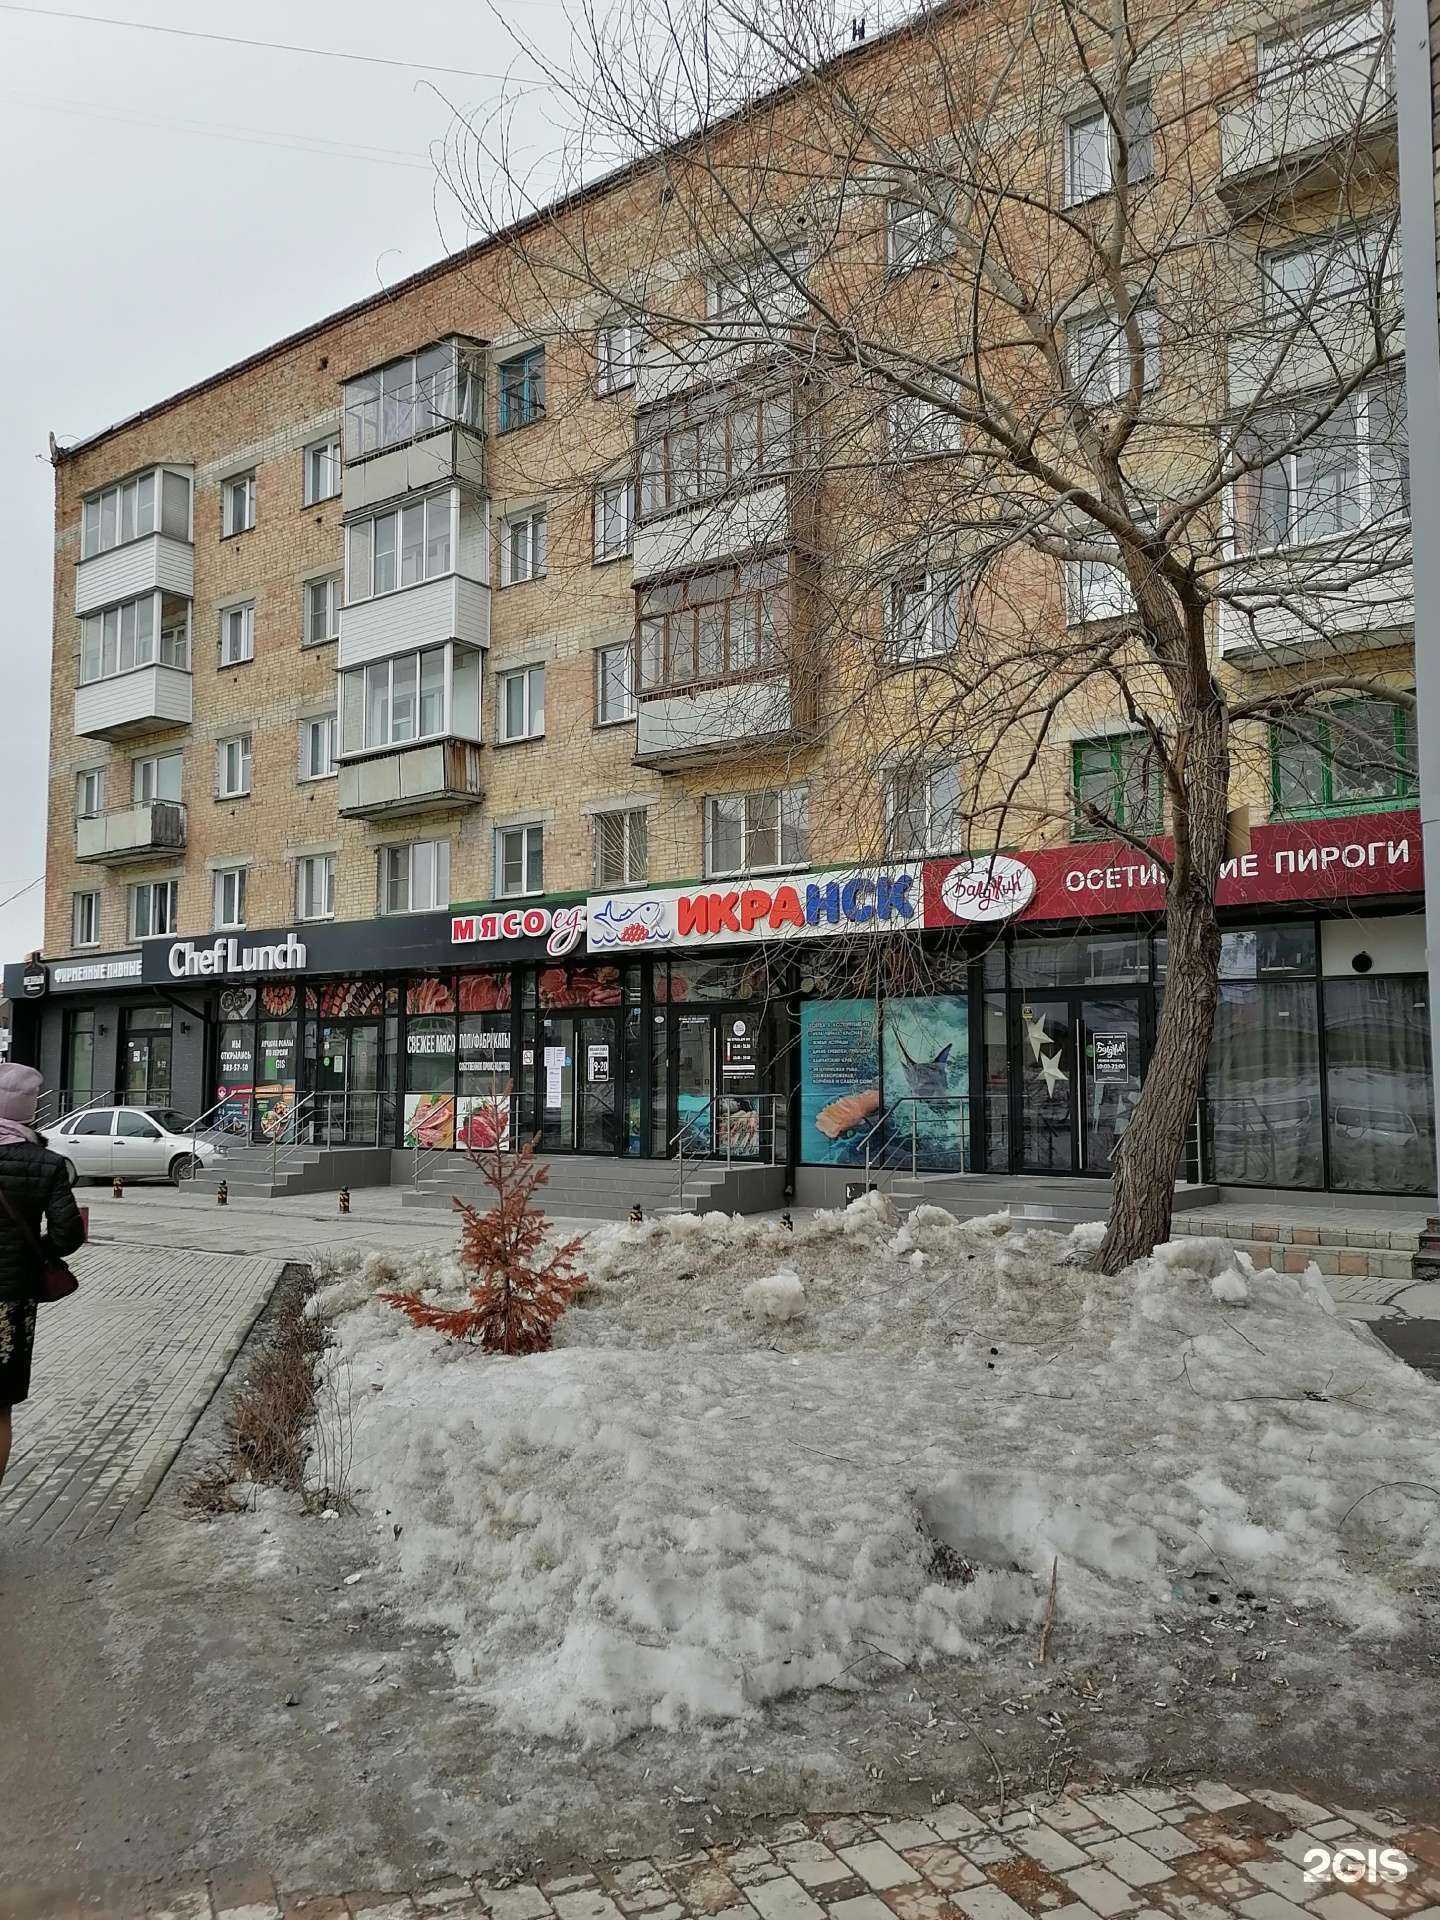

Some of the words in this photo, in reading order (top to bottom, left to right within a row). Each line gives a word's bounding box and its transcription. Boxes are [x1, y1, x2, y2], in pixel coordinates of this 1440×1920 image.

[1065, 854, 1259, 892] ОСЕТИИЕ
[1275, 839, 1410, 875] ПИРОГИ
[407, 1035, 435, 1054] СВЕЖЕЕ
[436, 1034, 456, 1053] МЯСО
[459, 1032, 511, 1049] ПОЛУФАБРИКАТЫ
[220, 1051, 252, 1060] ОТКРЫЛИСЬ
